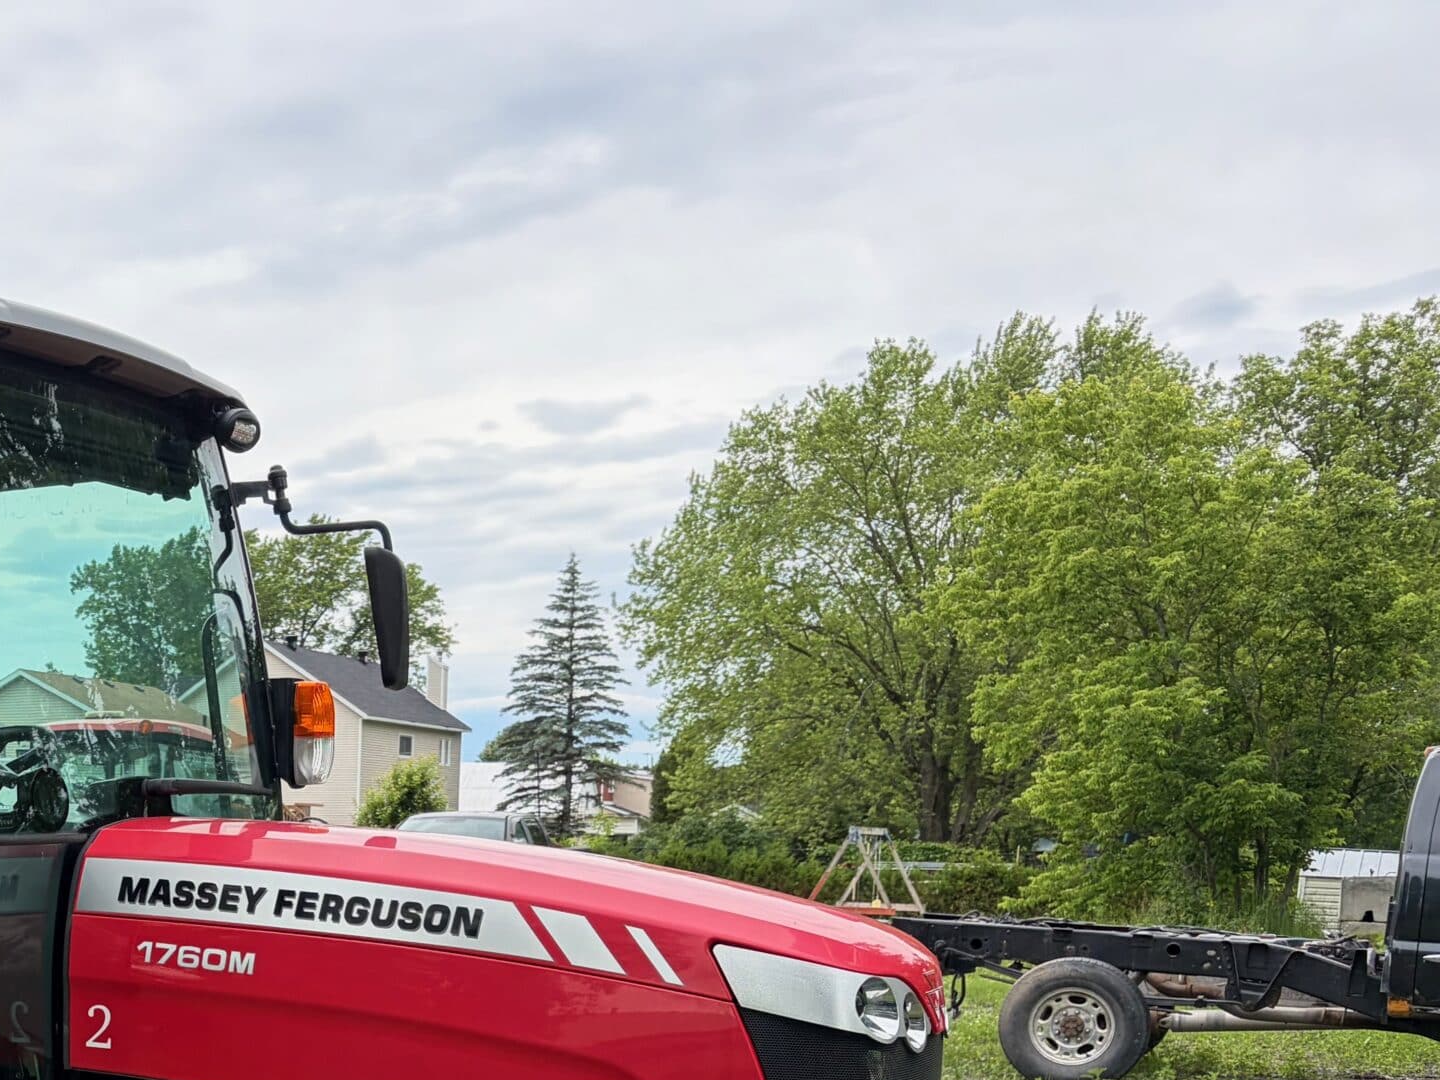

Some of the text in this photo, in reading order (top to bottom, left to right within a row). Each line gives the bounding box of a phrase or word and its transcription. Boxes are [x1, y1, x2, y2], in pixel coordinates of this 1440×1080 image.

[117, 875, 484, 938] MASSEY FERGUSON
[136, 940, 257, 976] 1760M
[84, 1004, 113, 1050] 2
